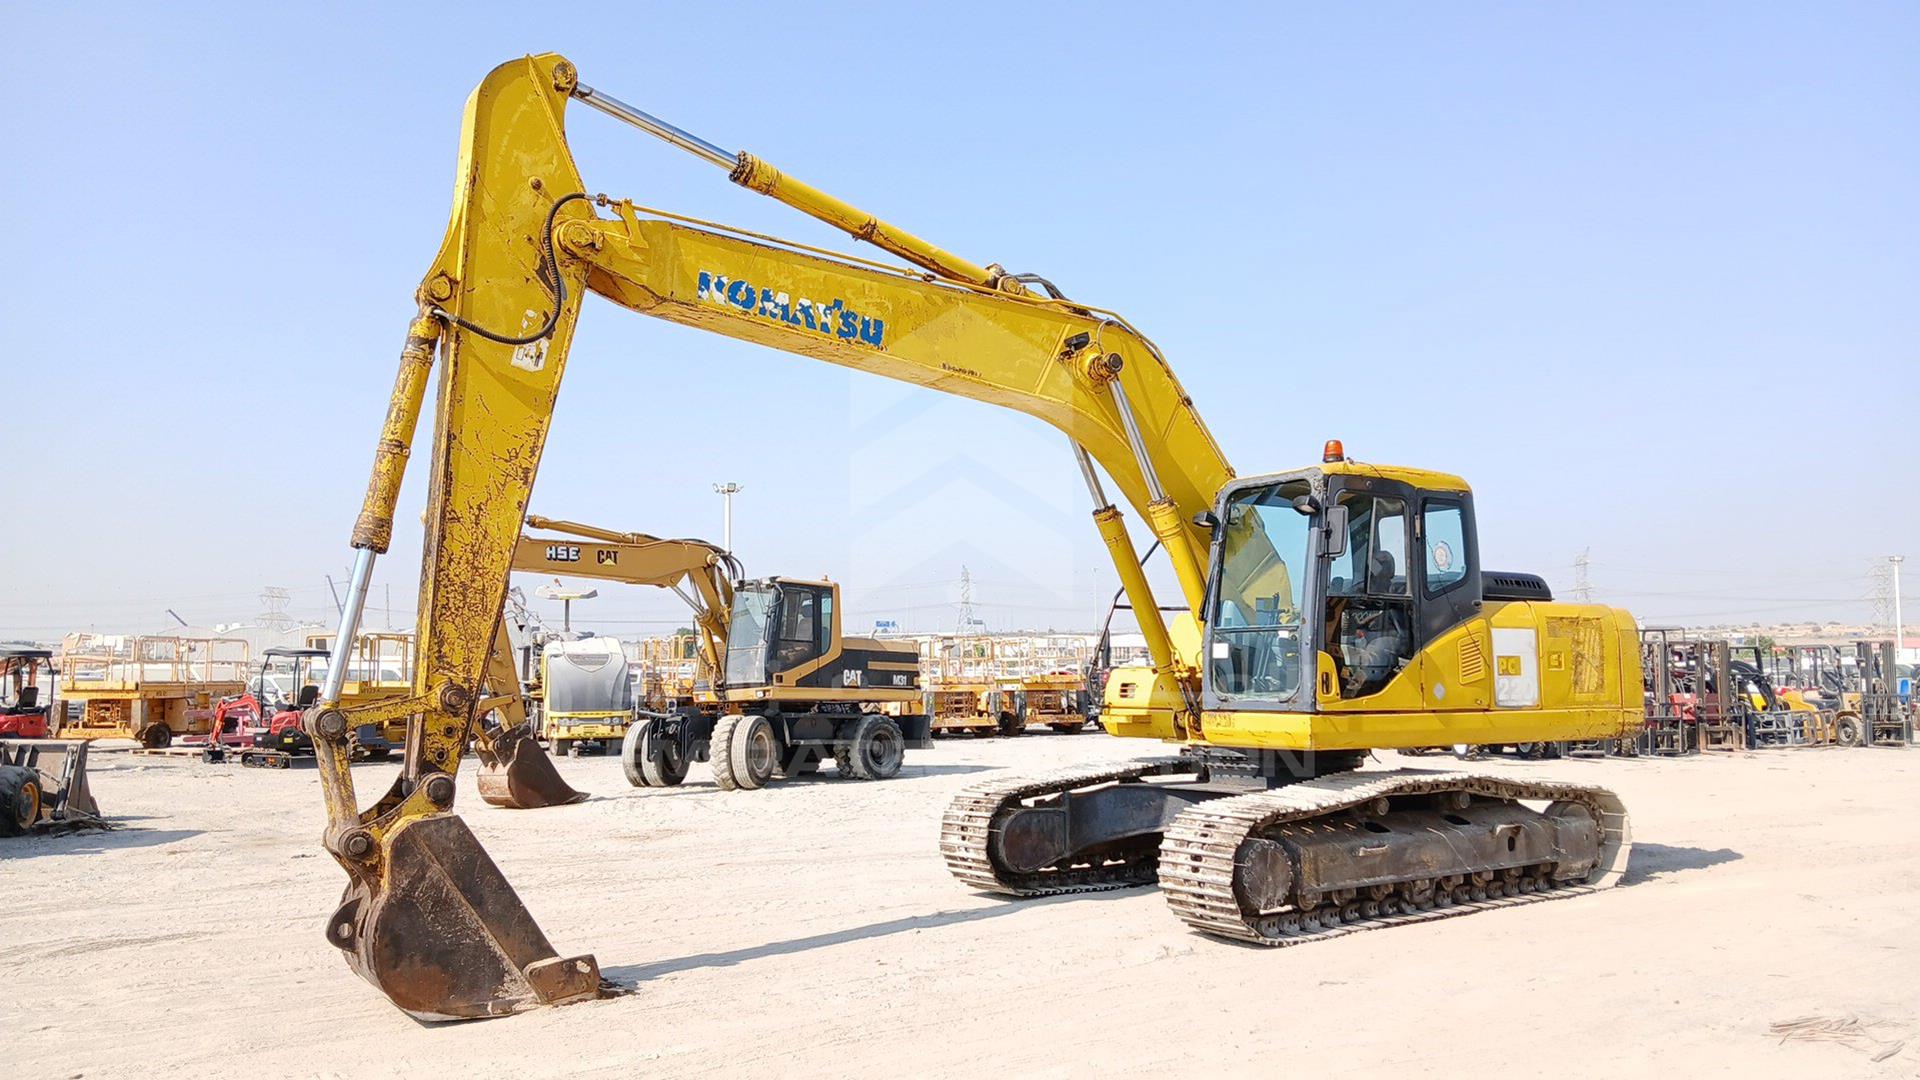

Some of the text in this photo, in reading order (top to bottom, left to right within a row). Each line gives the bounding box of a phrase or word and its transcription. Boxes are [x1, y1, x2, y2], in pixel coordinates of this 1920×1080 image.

[697, 269, 884, 346] KOMATSU
[546, 545, 580, 561] HSE
[597, 550, 618, 564] CAT
[1498, 657, 1519, 674] PC
[843, 669, 862, 686] CAT
